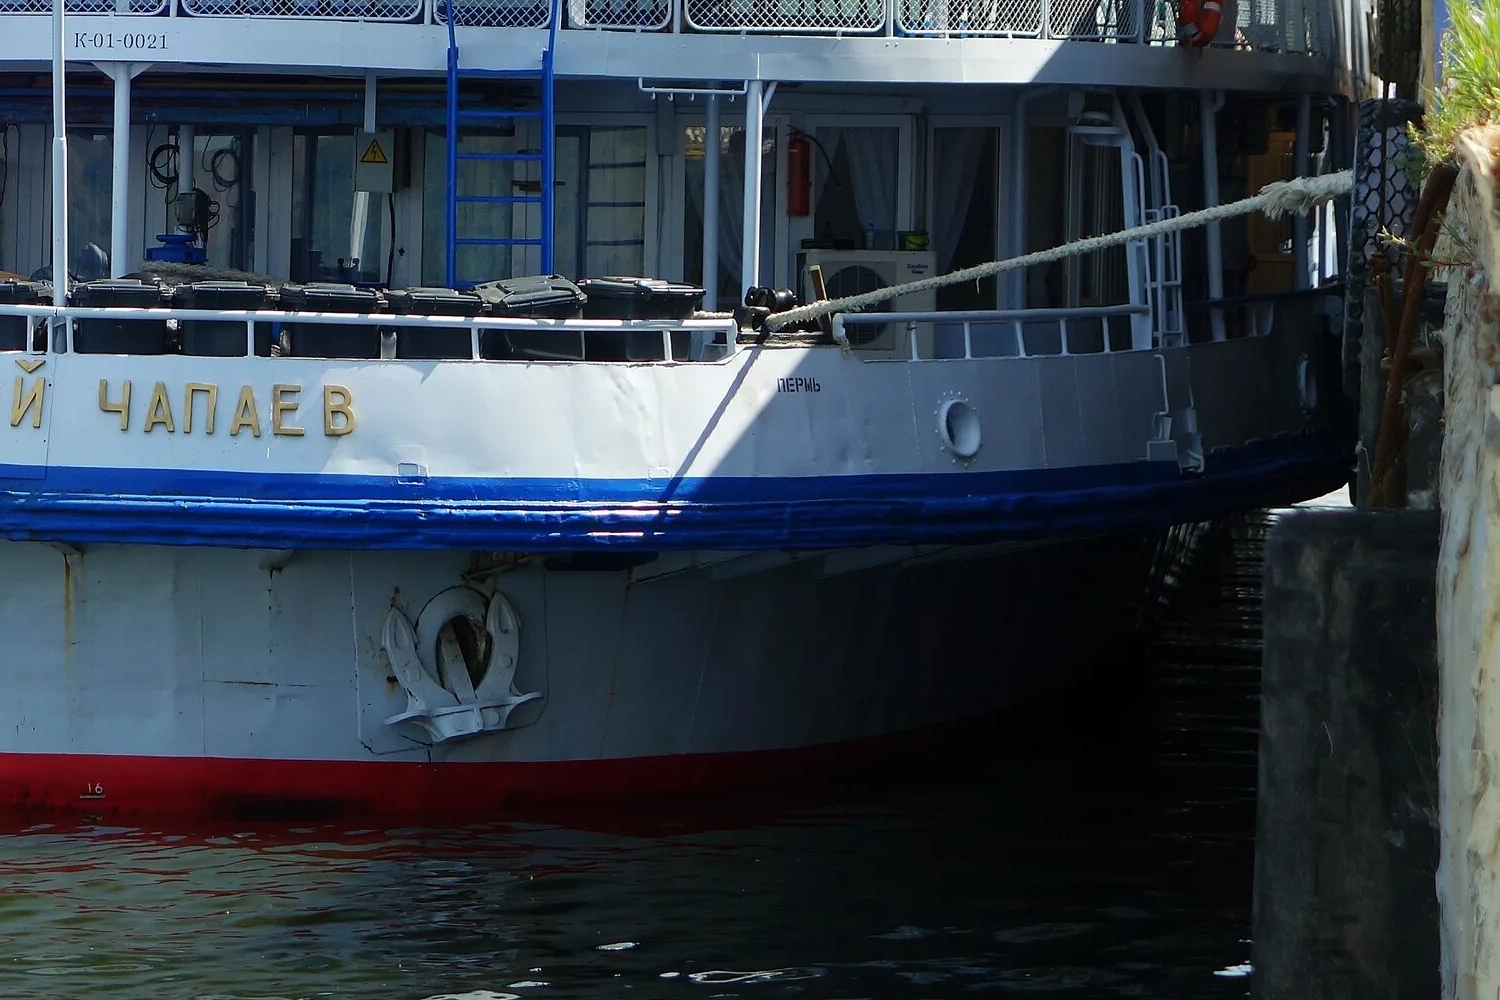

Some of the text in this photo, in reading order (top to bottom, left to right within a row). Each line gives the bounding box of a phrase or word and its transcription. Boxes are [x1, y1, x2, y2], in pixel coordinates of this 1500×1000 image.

[74, 32, 168, 49] К-01-0021
[776, 376, 821, 393] ПЕРМЬ
[98, 378, 357, 437] ЧАПАЕВ
[87, 782, 103, 794] 16
